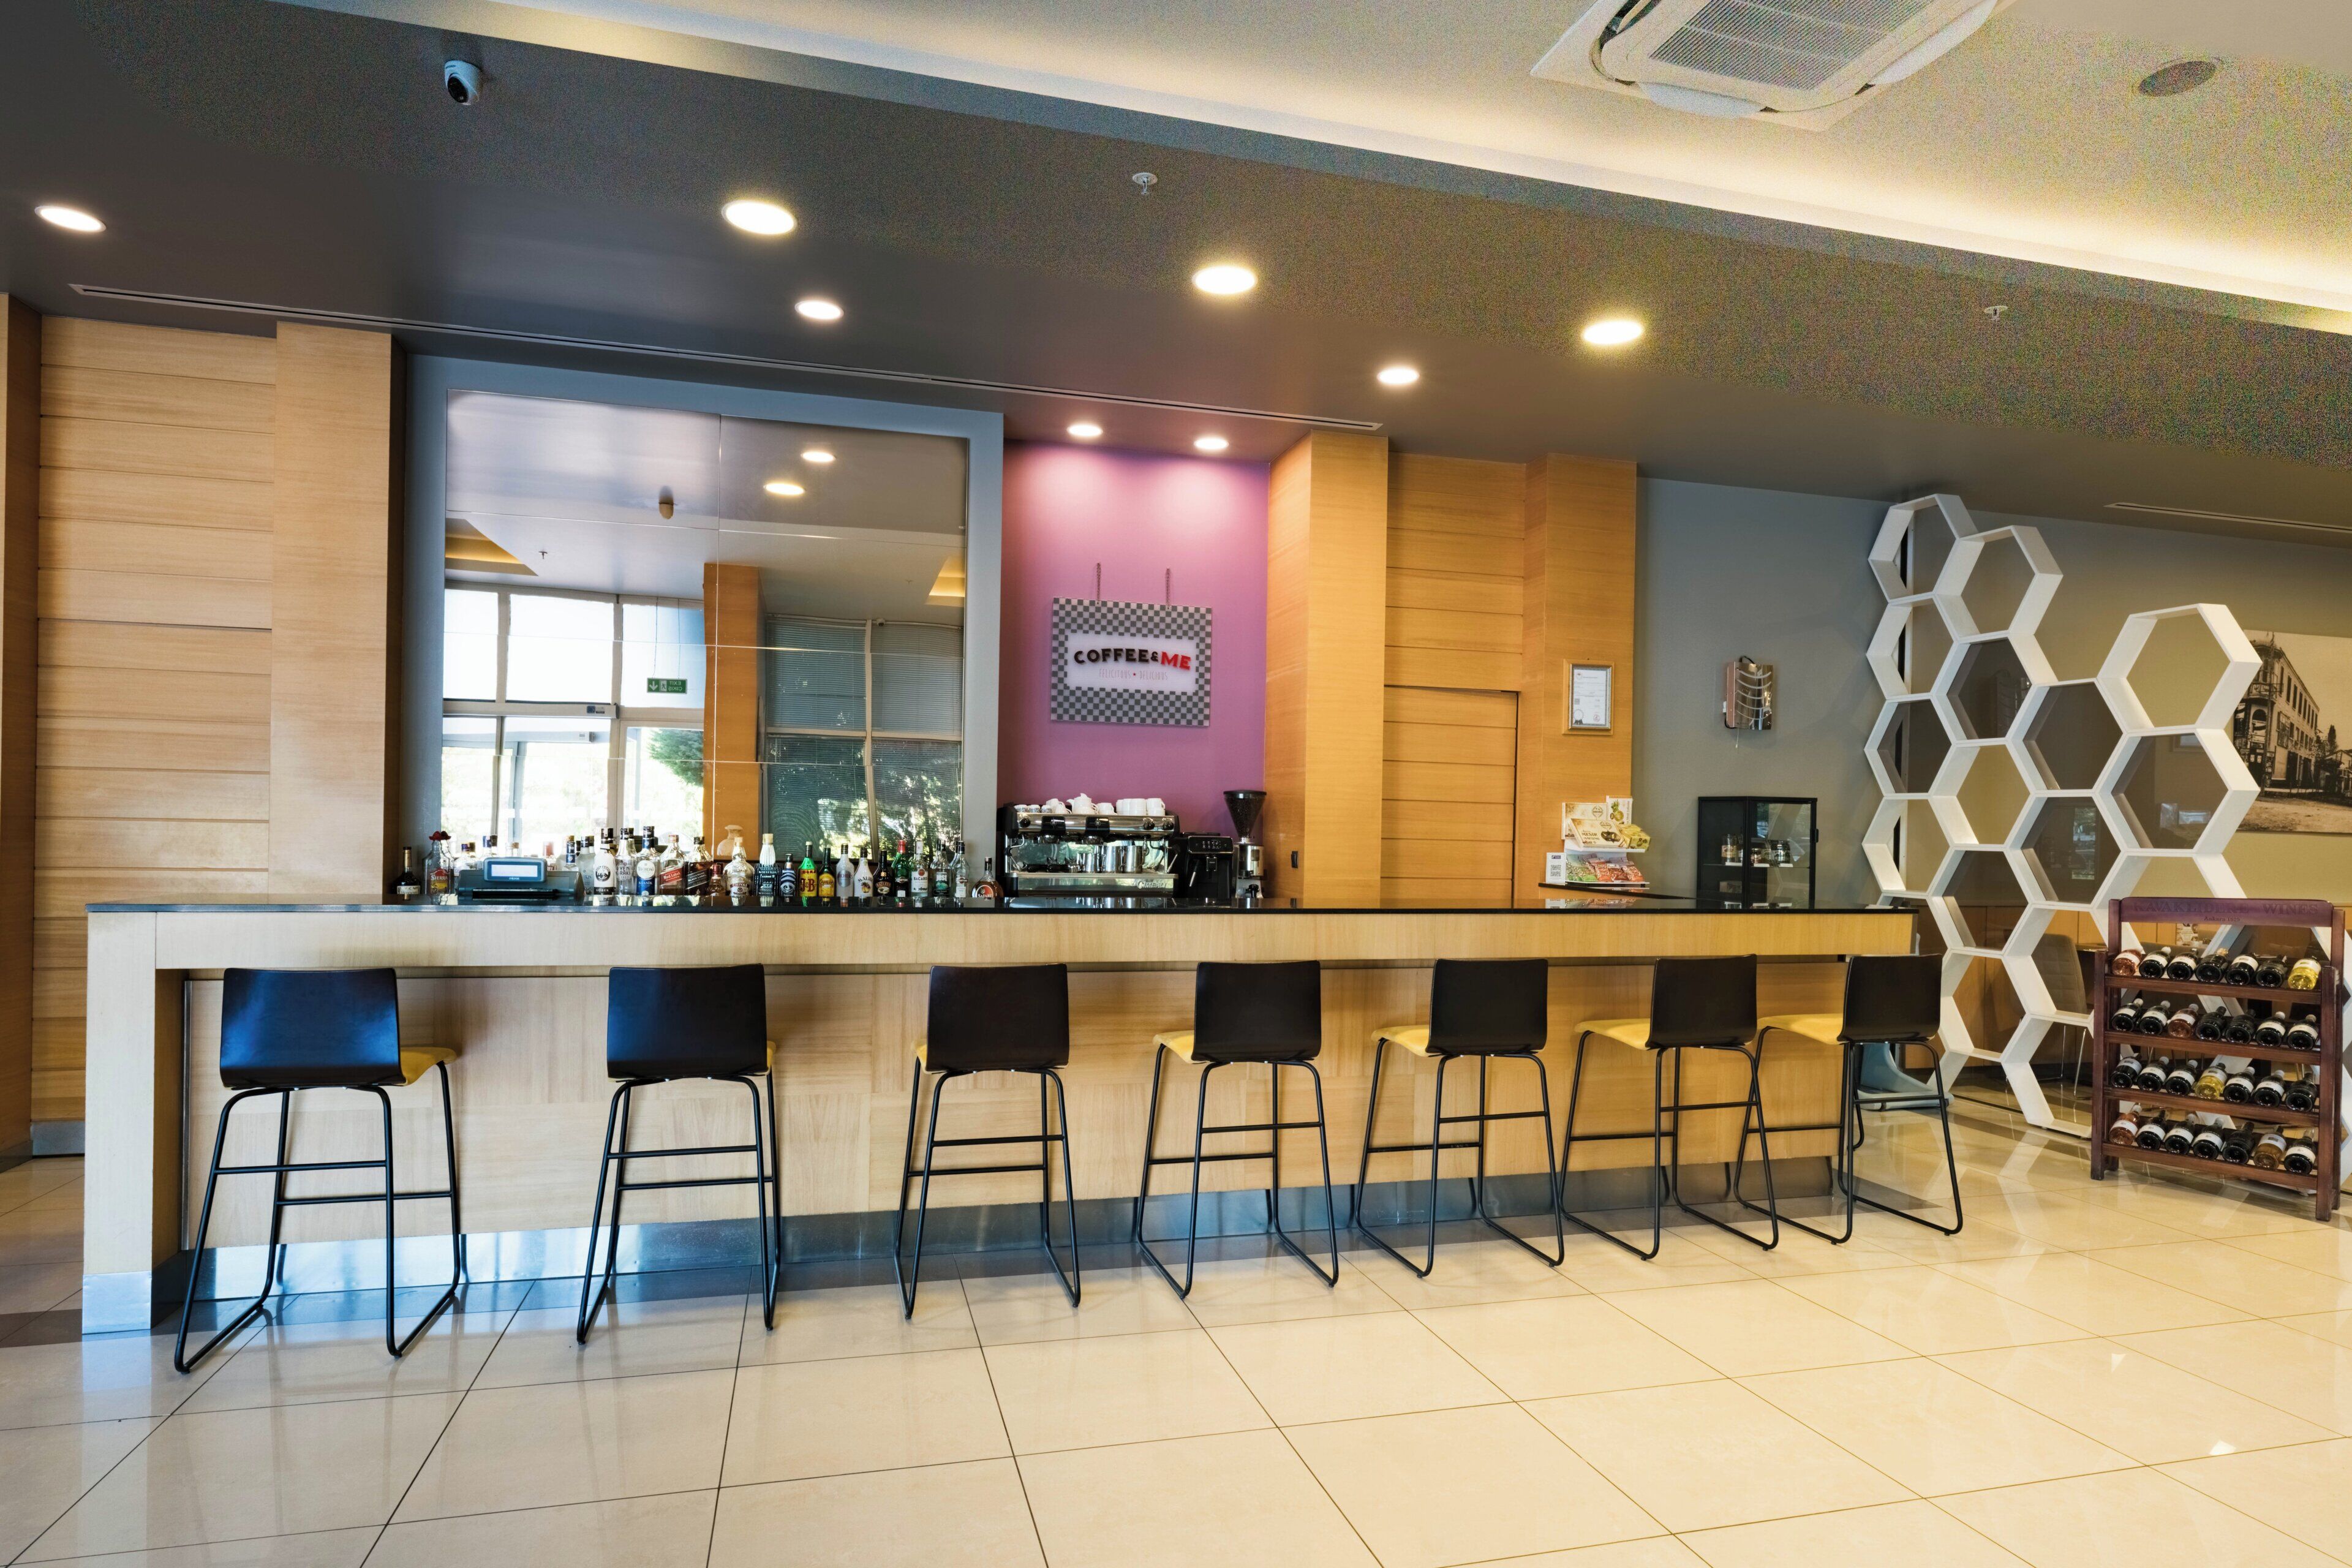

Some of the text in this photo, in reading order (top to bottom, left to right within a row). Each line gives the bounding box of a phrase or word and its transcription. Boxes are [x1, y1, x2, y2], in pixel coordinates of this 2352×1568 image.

[1099, 668, 1168, 681] FELICITOUS DELICIOUS
[2263, 903, 2318, 915] WINES
